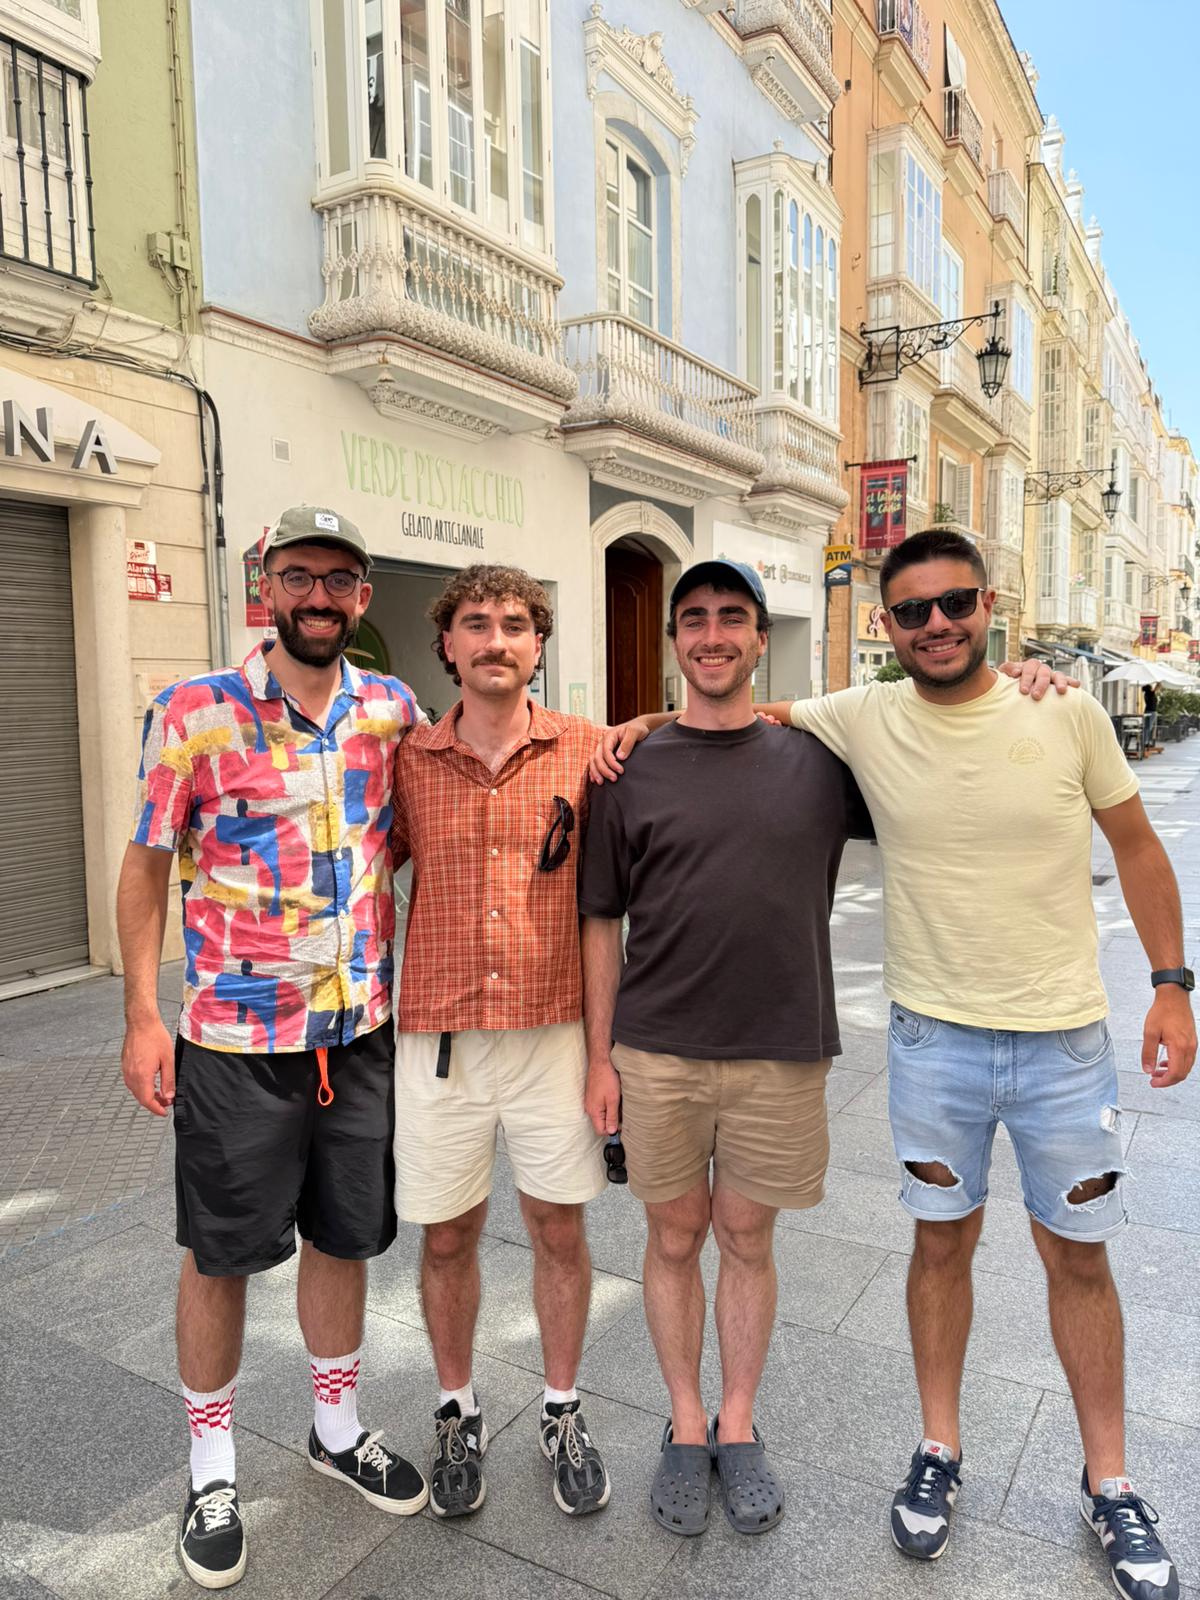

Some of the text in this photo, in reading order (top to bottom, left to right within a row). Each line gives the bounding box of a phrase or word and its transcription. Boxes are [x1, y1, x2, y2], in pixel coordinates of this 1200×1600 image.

[340, 430, 525, 528] VERDE PISTACCHIO
[401, 511, 485, 549] GELATO ARTIGIANALE
[826, 551, 852, 561] ATM
